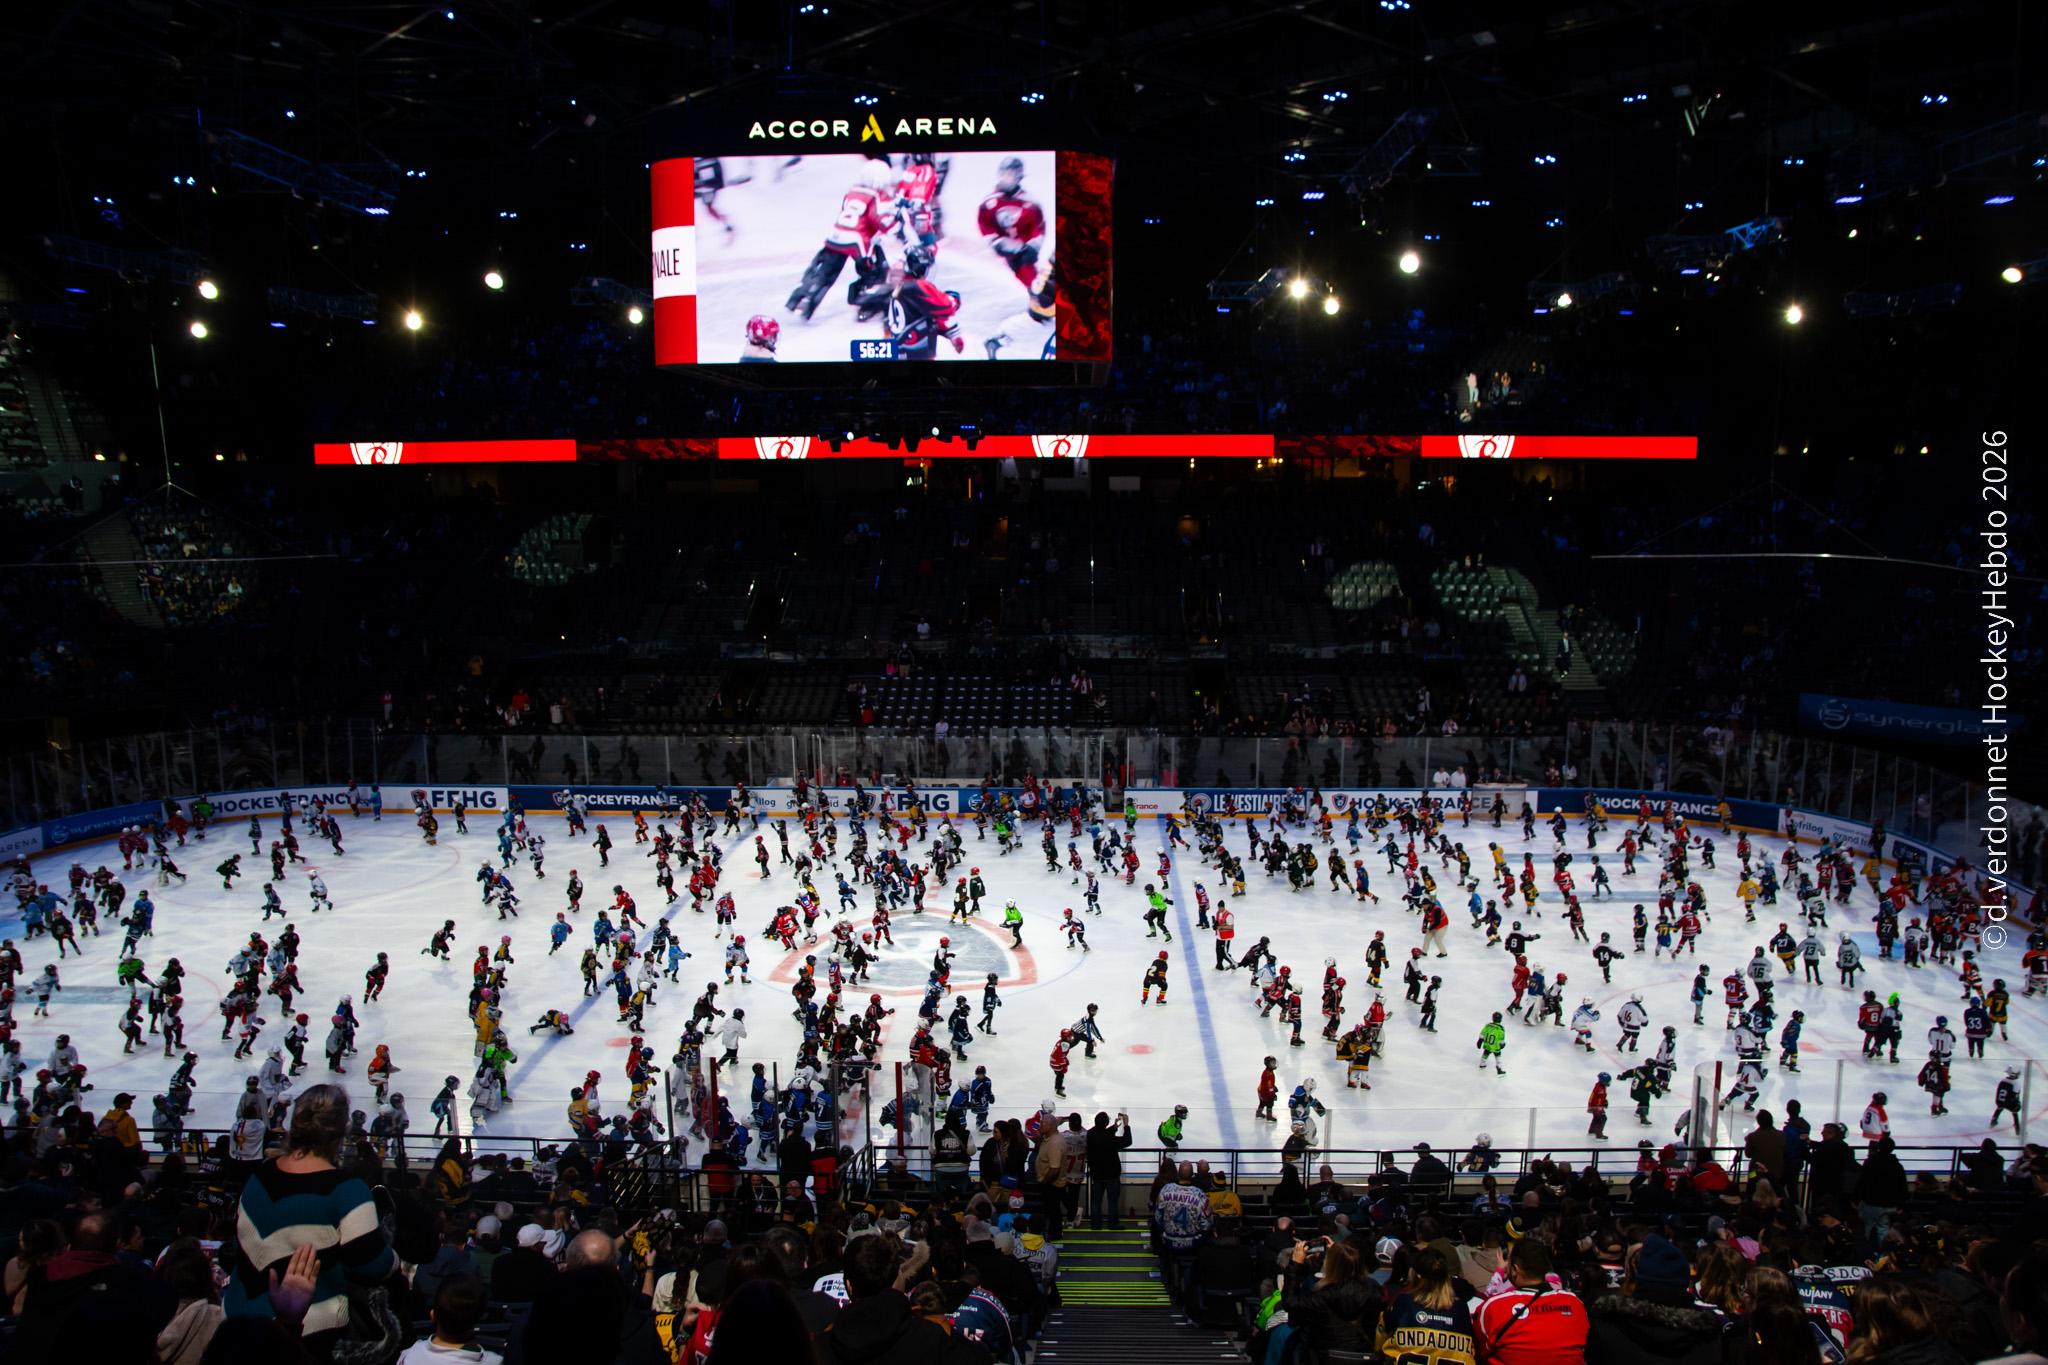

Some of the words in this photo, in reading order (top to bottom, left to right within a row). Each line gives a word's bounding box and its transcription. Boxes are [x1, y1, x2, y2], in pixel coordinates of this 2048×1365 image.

[748, 120, 850, 139] ACCOR
[895, 117, 997, 136] ARENA
[859, 342, 892, 359] 56:21
[1967, 1017, 1983, 1030] 33
[1485, 1034, 1496, 1045] 10
[1925, 1069, 1938, 1084] 14
[1174, 1206, 1189, 1231] 4
